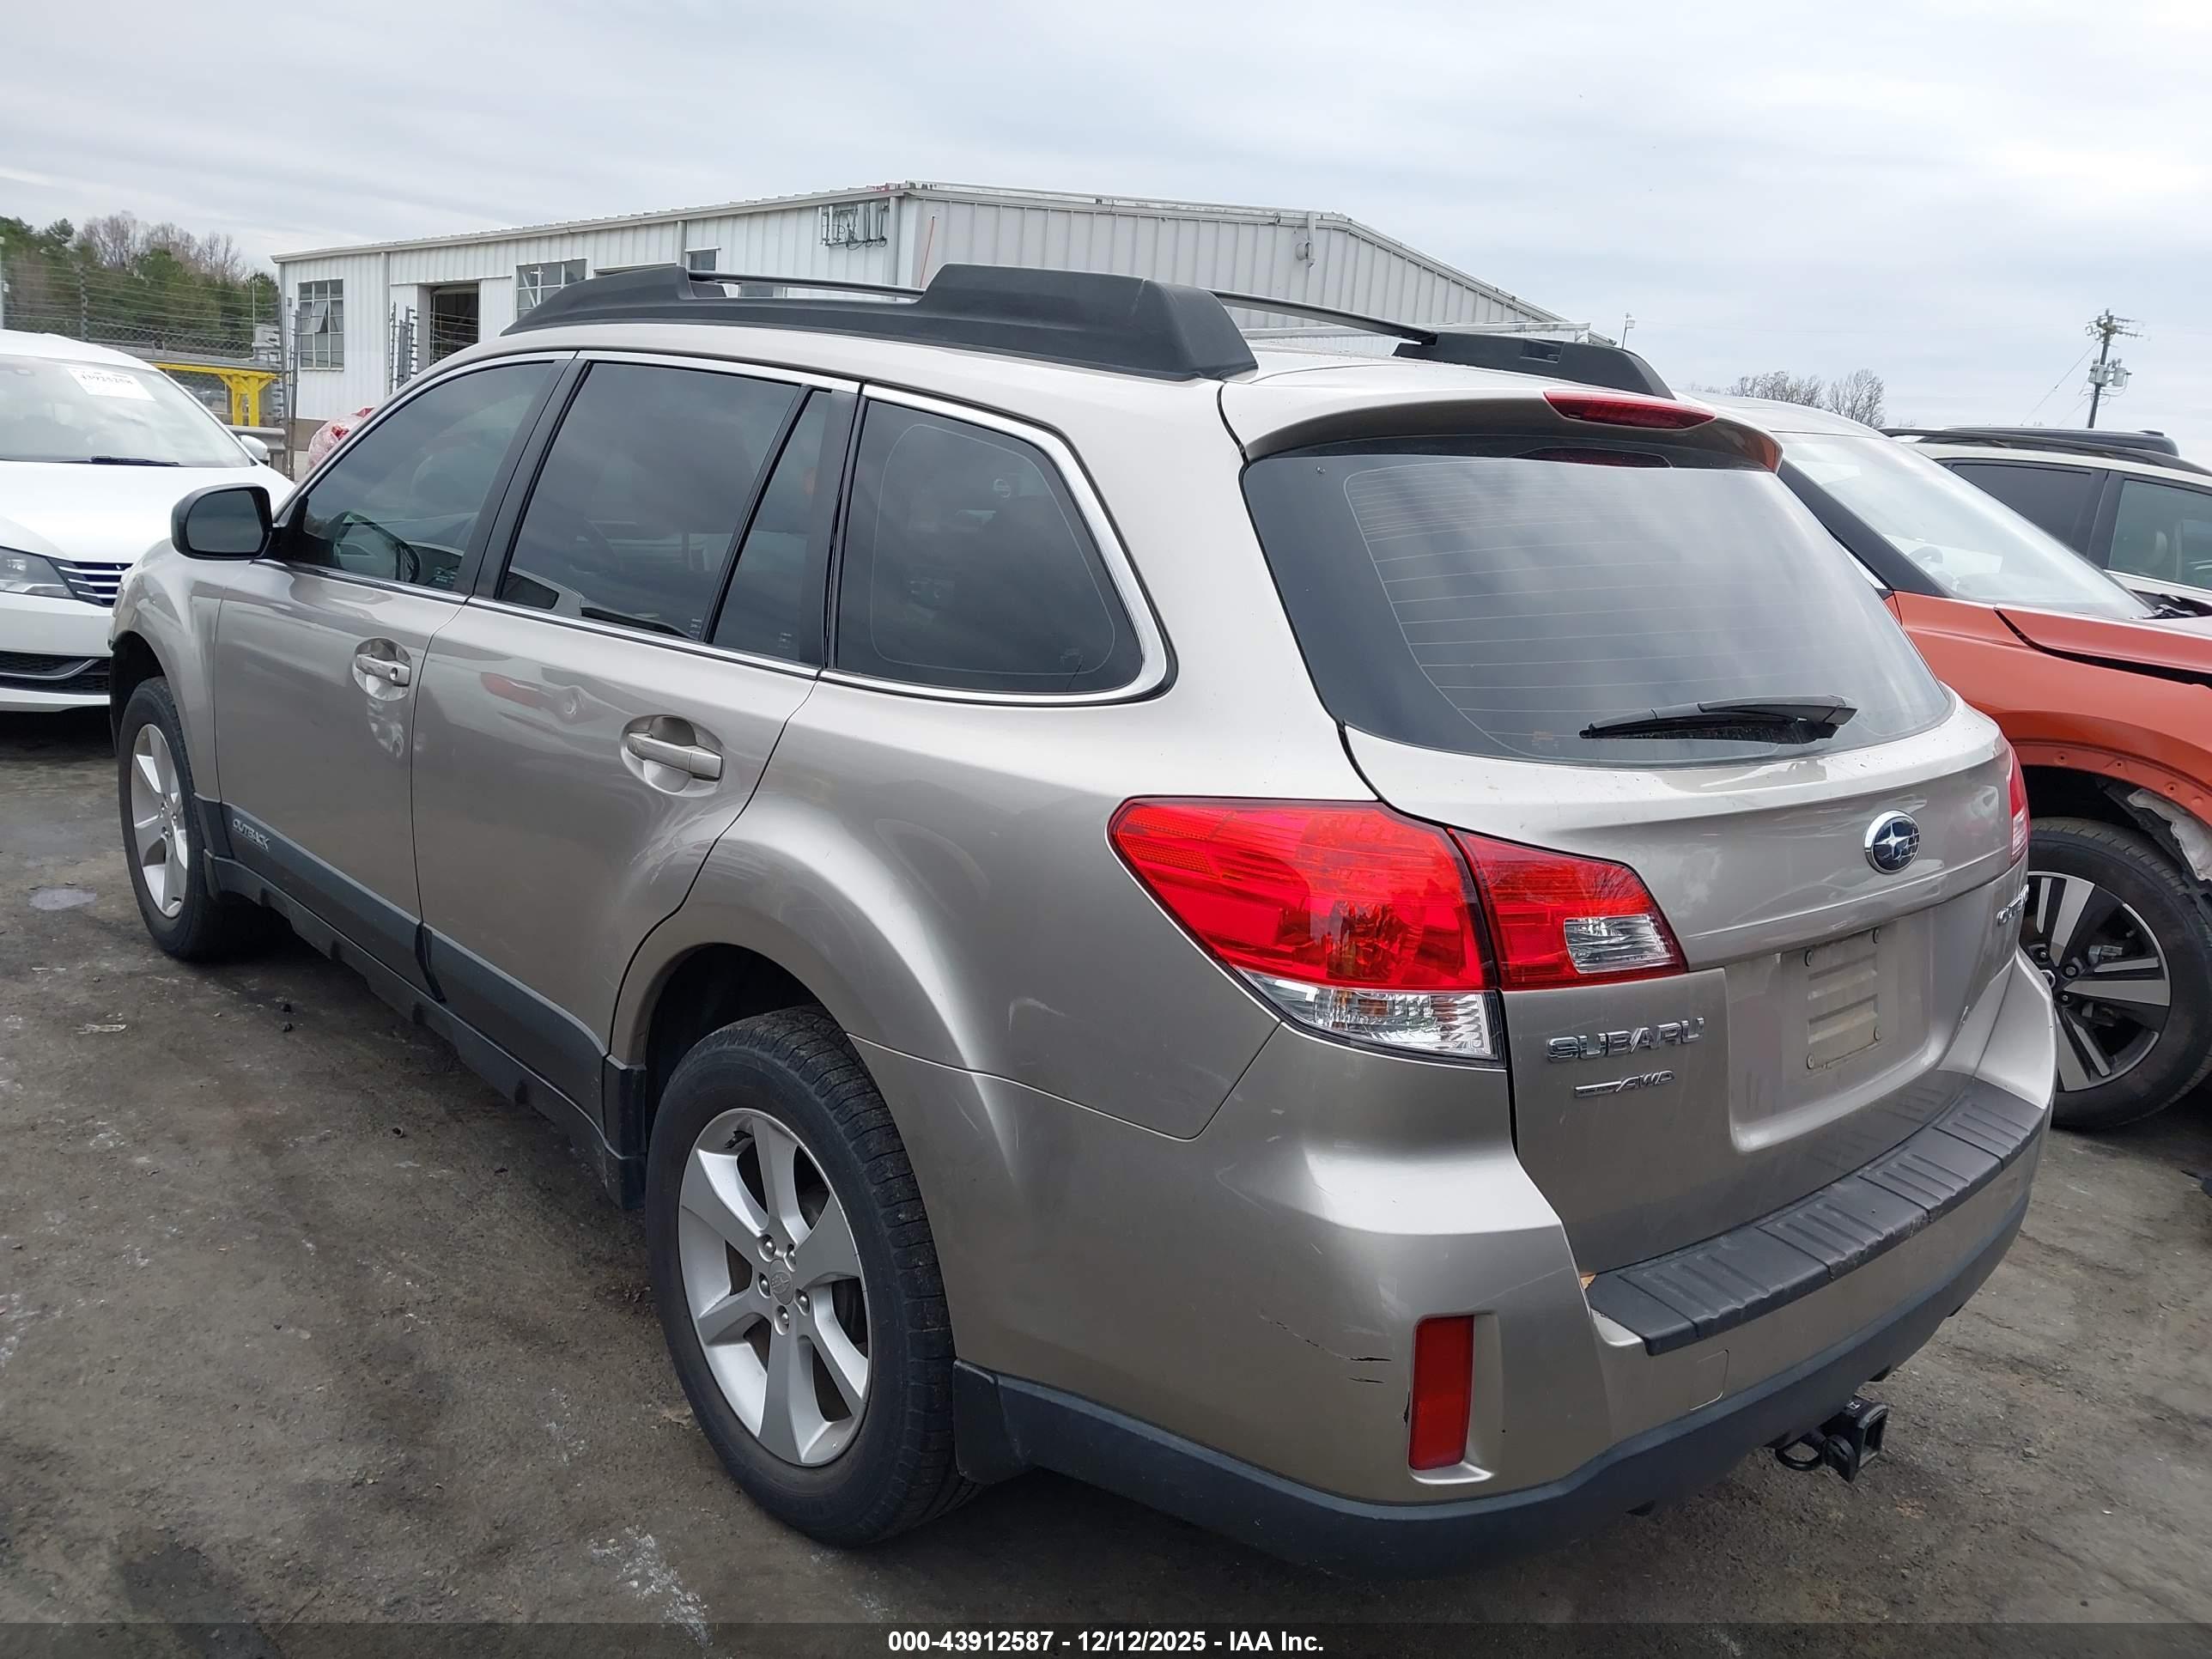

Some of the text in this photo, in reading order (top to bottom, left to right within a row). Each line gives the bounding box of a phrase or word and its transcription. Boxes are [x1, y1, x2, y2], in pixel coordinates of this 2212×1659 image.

[233, 818, 270, 853] OUTBACK
[1547, 1017, 1705, 1061] SUBARU
[1615, 1070, 1674, 1092] AWD
